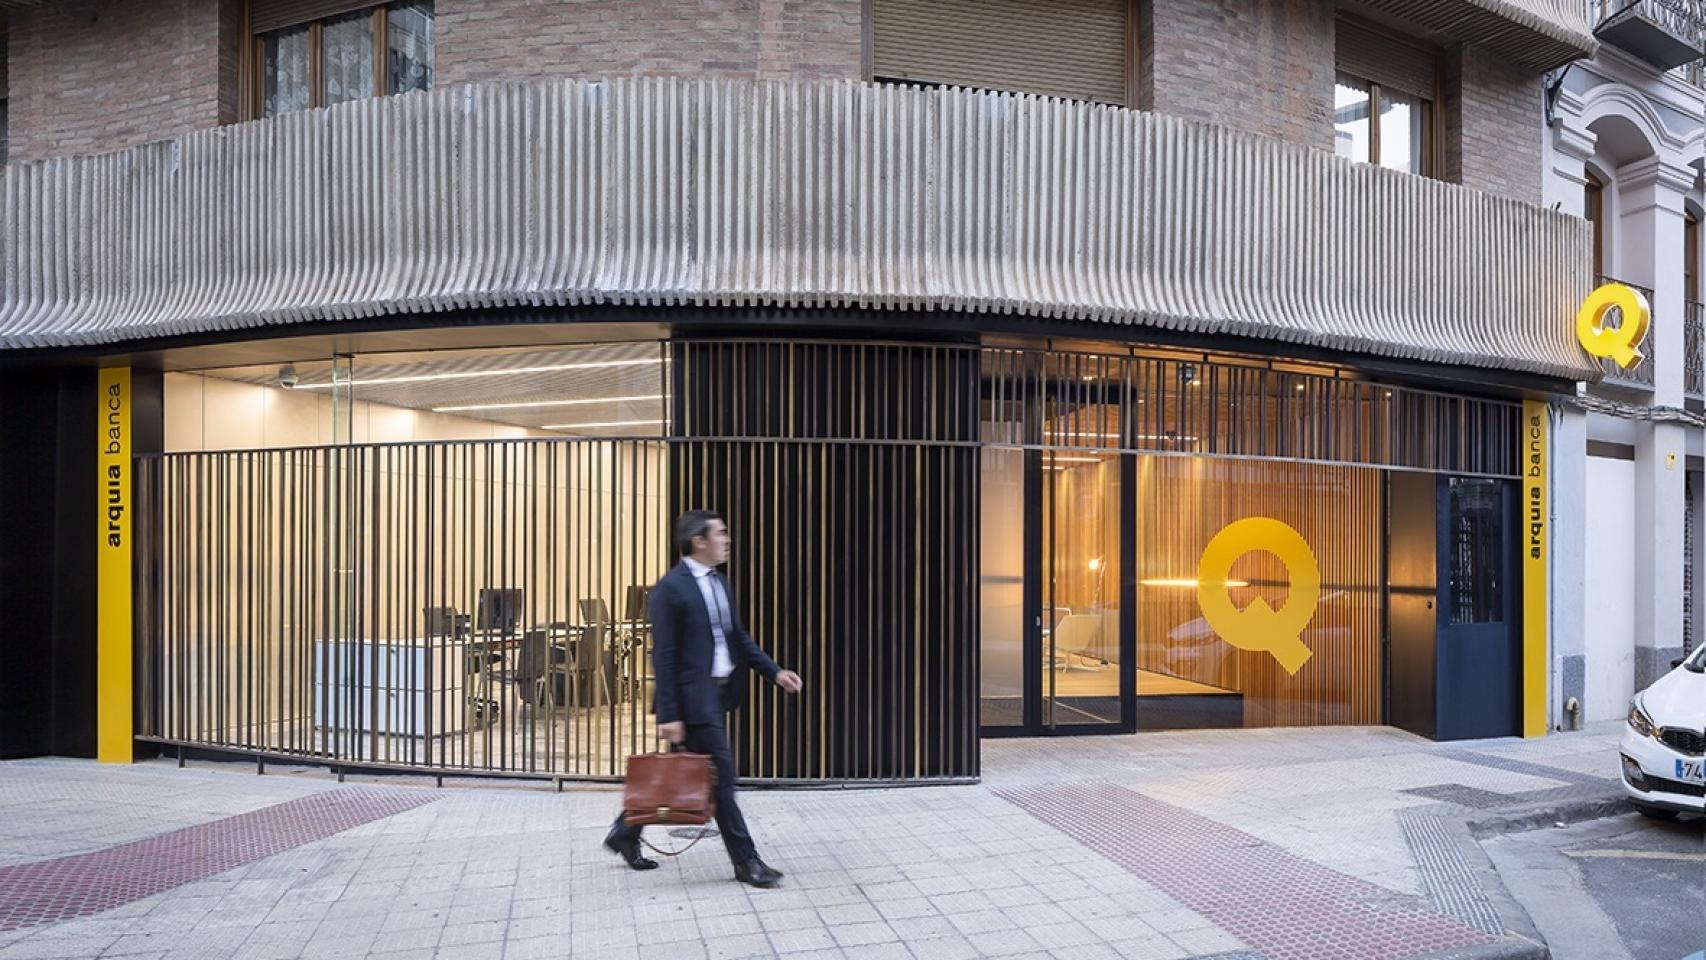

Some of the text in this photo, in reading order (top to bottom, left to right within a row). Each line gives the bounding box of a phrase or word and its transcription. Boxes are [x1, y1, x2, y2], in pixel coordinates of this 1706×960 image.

[1577, 282, 1651, 370] Q
[105, 383, 121, 454] banca
[1528, 415, 1541, 477] banca
[1198, 516, 1320, 676] Q
